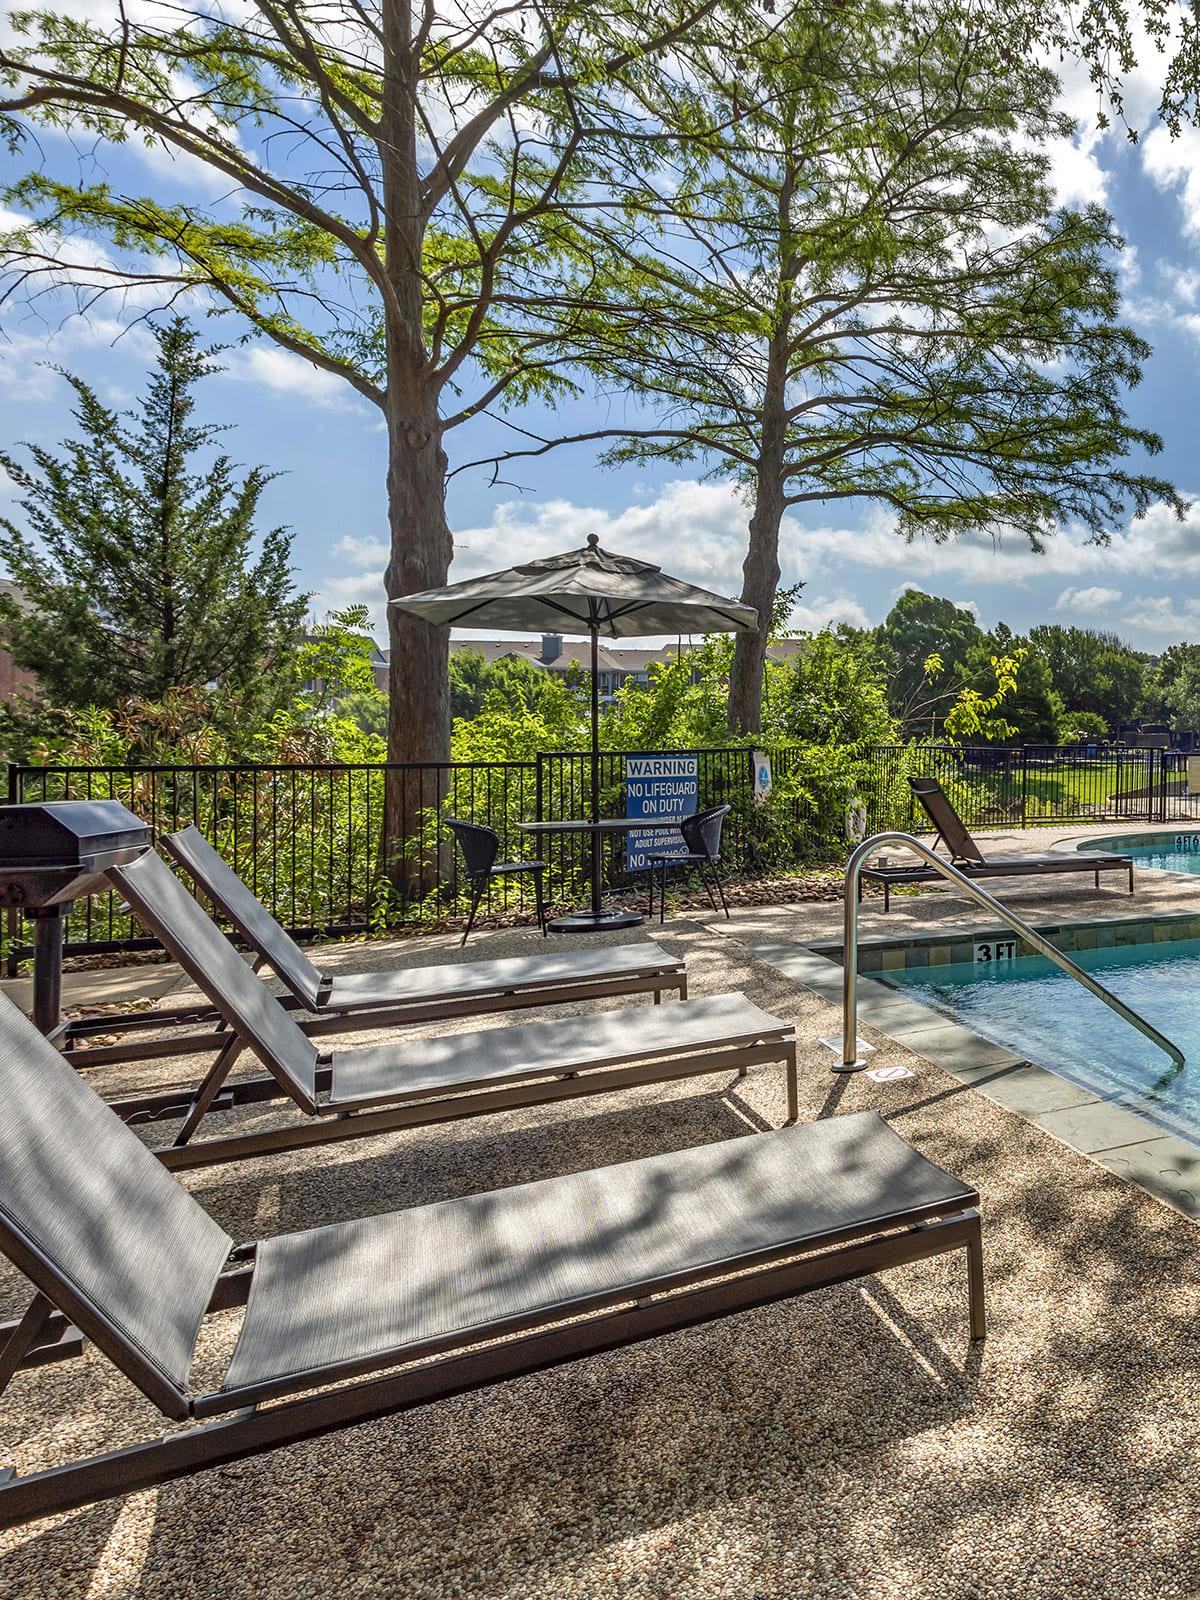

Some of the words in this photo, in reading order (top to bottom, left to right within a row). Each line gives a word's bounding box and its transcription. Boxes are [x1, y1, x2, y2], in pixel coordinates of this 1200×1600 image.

[629, 761, 695, 776] WARNING
[628, 783, 643, 797] NO
[645, 781, 697, 797] LIFEGUARD
[642, 800, 657, 814] ON
[660, 798, 684, 812] DUTY
[629, 829, 642, 838] NOT
[643, 828, 654, 837] USE
[655, 828, 669, 836] POOL
[1176, 836, 1182, 844] 4
[1183, 835, 1191, 845] FT
[1192, 835, 1199, 845] 6
[634, 838, 653, 849] ADULT
[630, 853, 645, 868] NO
[977, 944, 992, 962] 3
[996, 942, 1015, 960] FT
